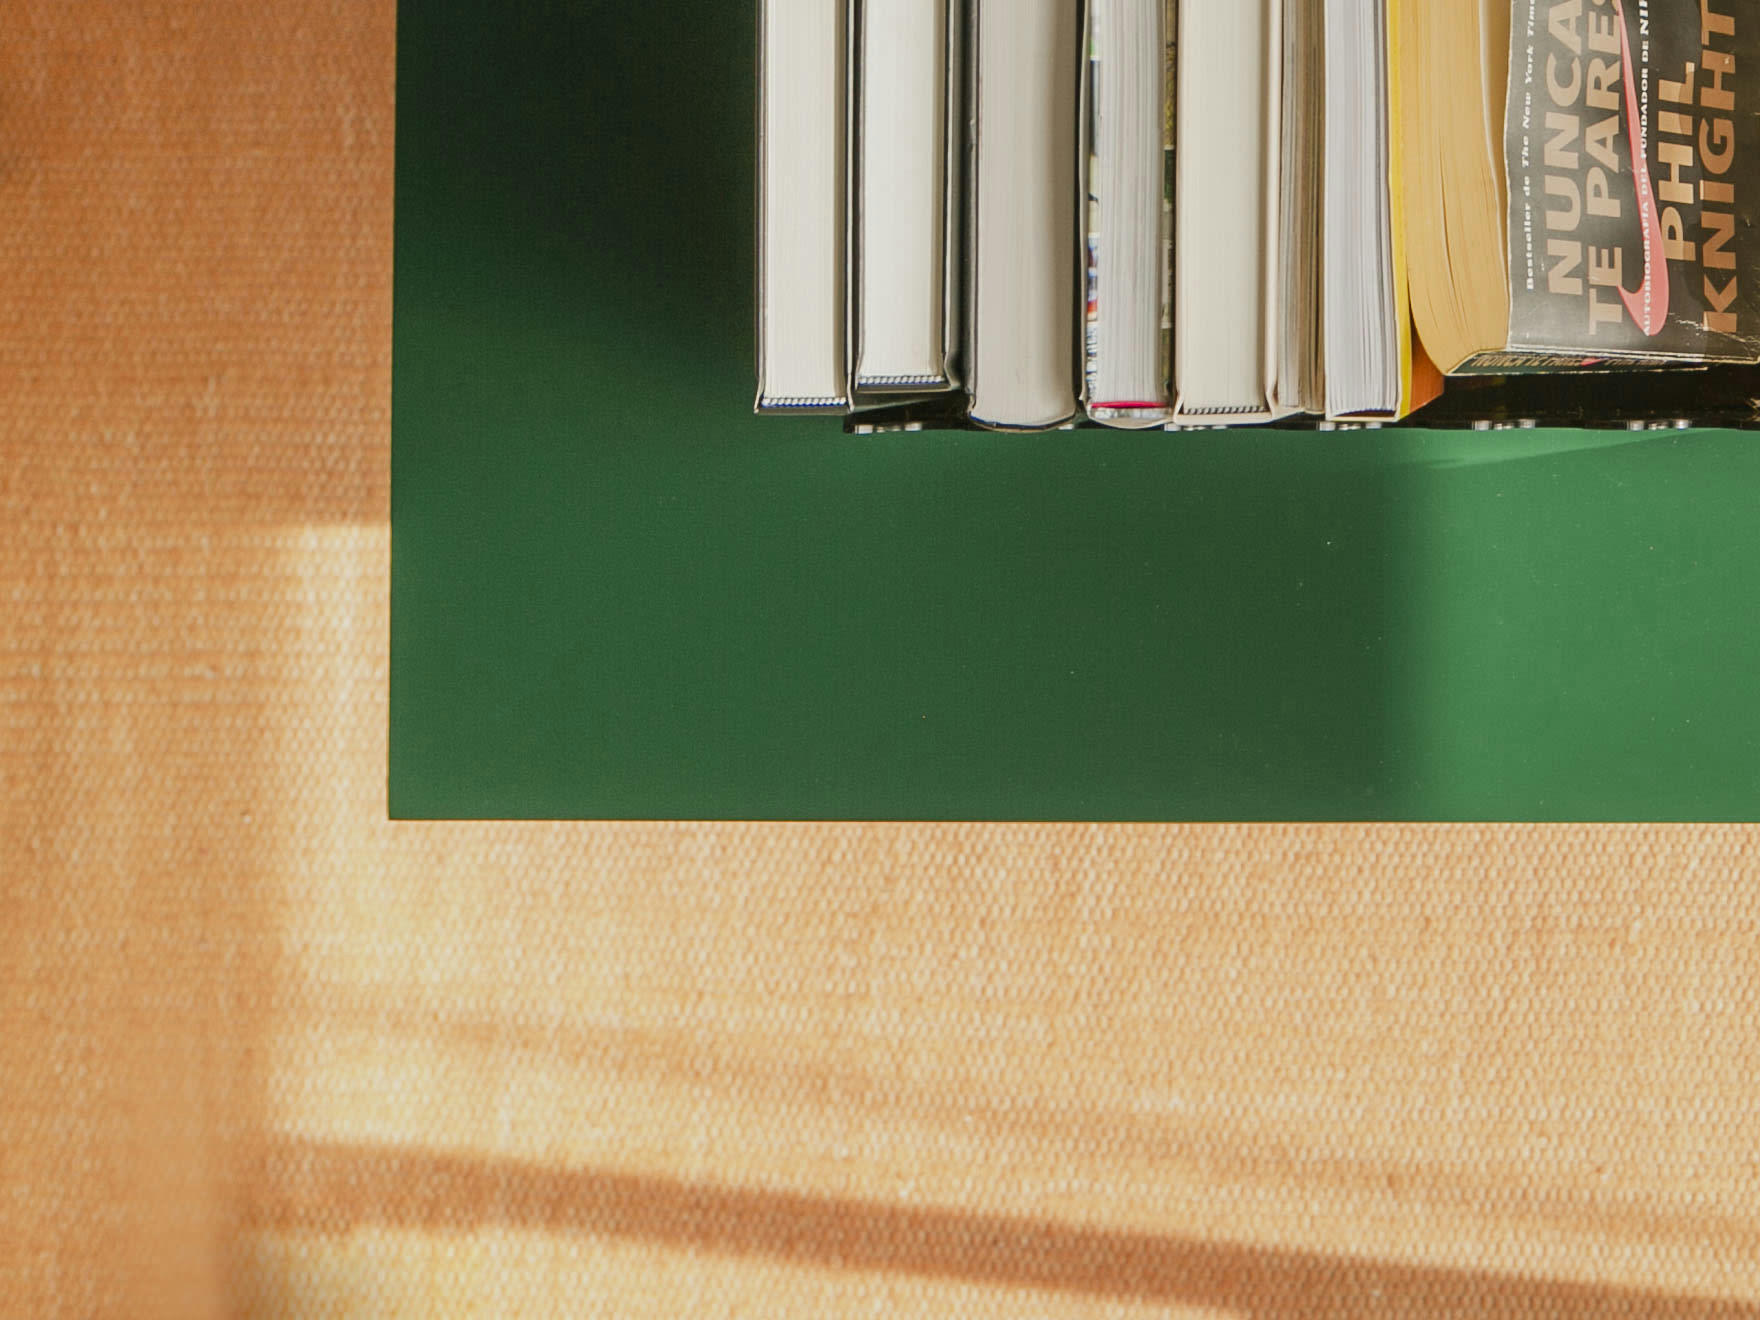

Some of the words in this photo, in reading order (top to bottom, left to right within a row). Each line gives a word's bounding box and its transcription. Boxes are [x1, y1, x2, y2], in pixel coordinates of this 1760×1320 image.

[1524, 46, 1534, 84] York
[1641, 40, 1649, 63] DE
[1522, 92, 1532, 129] New
[1640, 67, 1649, 161] FUNDADOR
[1521, 135, 1530, 169] The
[1657, 62, 1697, 262] PHIL
[1522, 176, 1531, 197] de
[1640, 161, 1649, 196] DEL
[1523, 202, 1534, 291] Bestseller
[1588, 245, 1623, 336] TE
